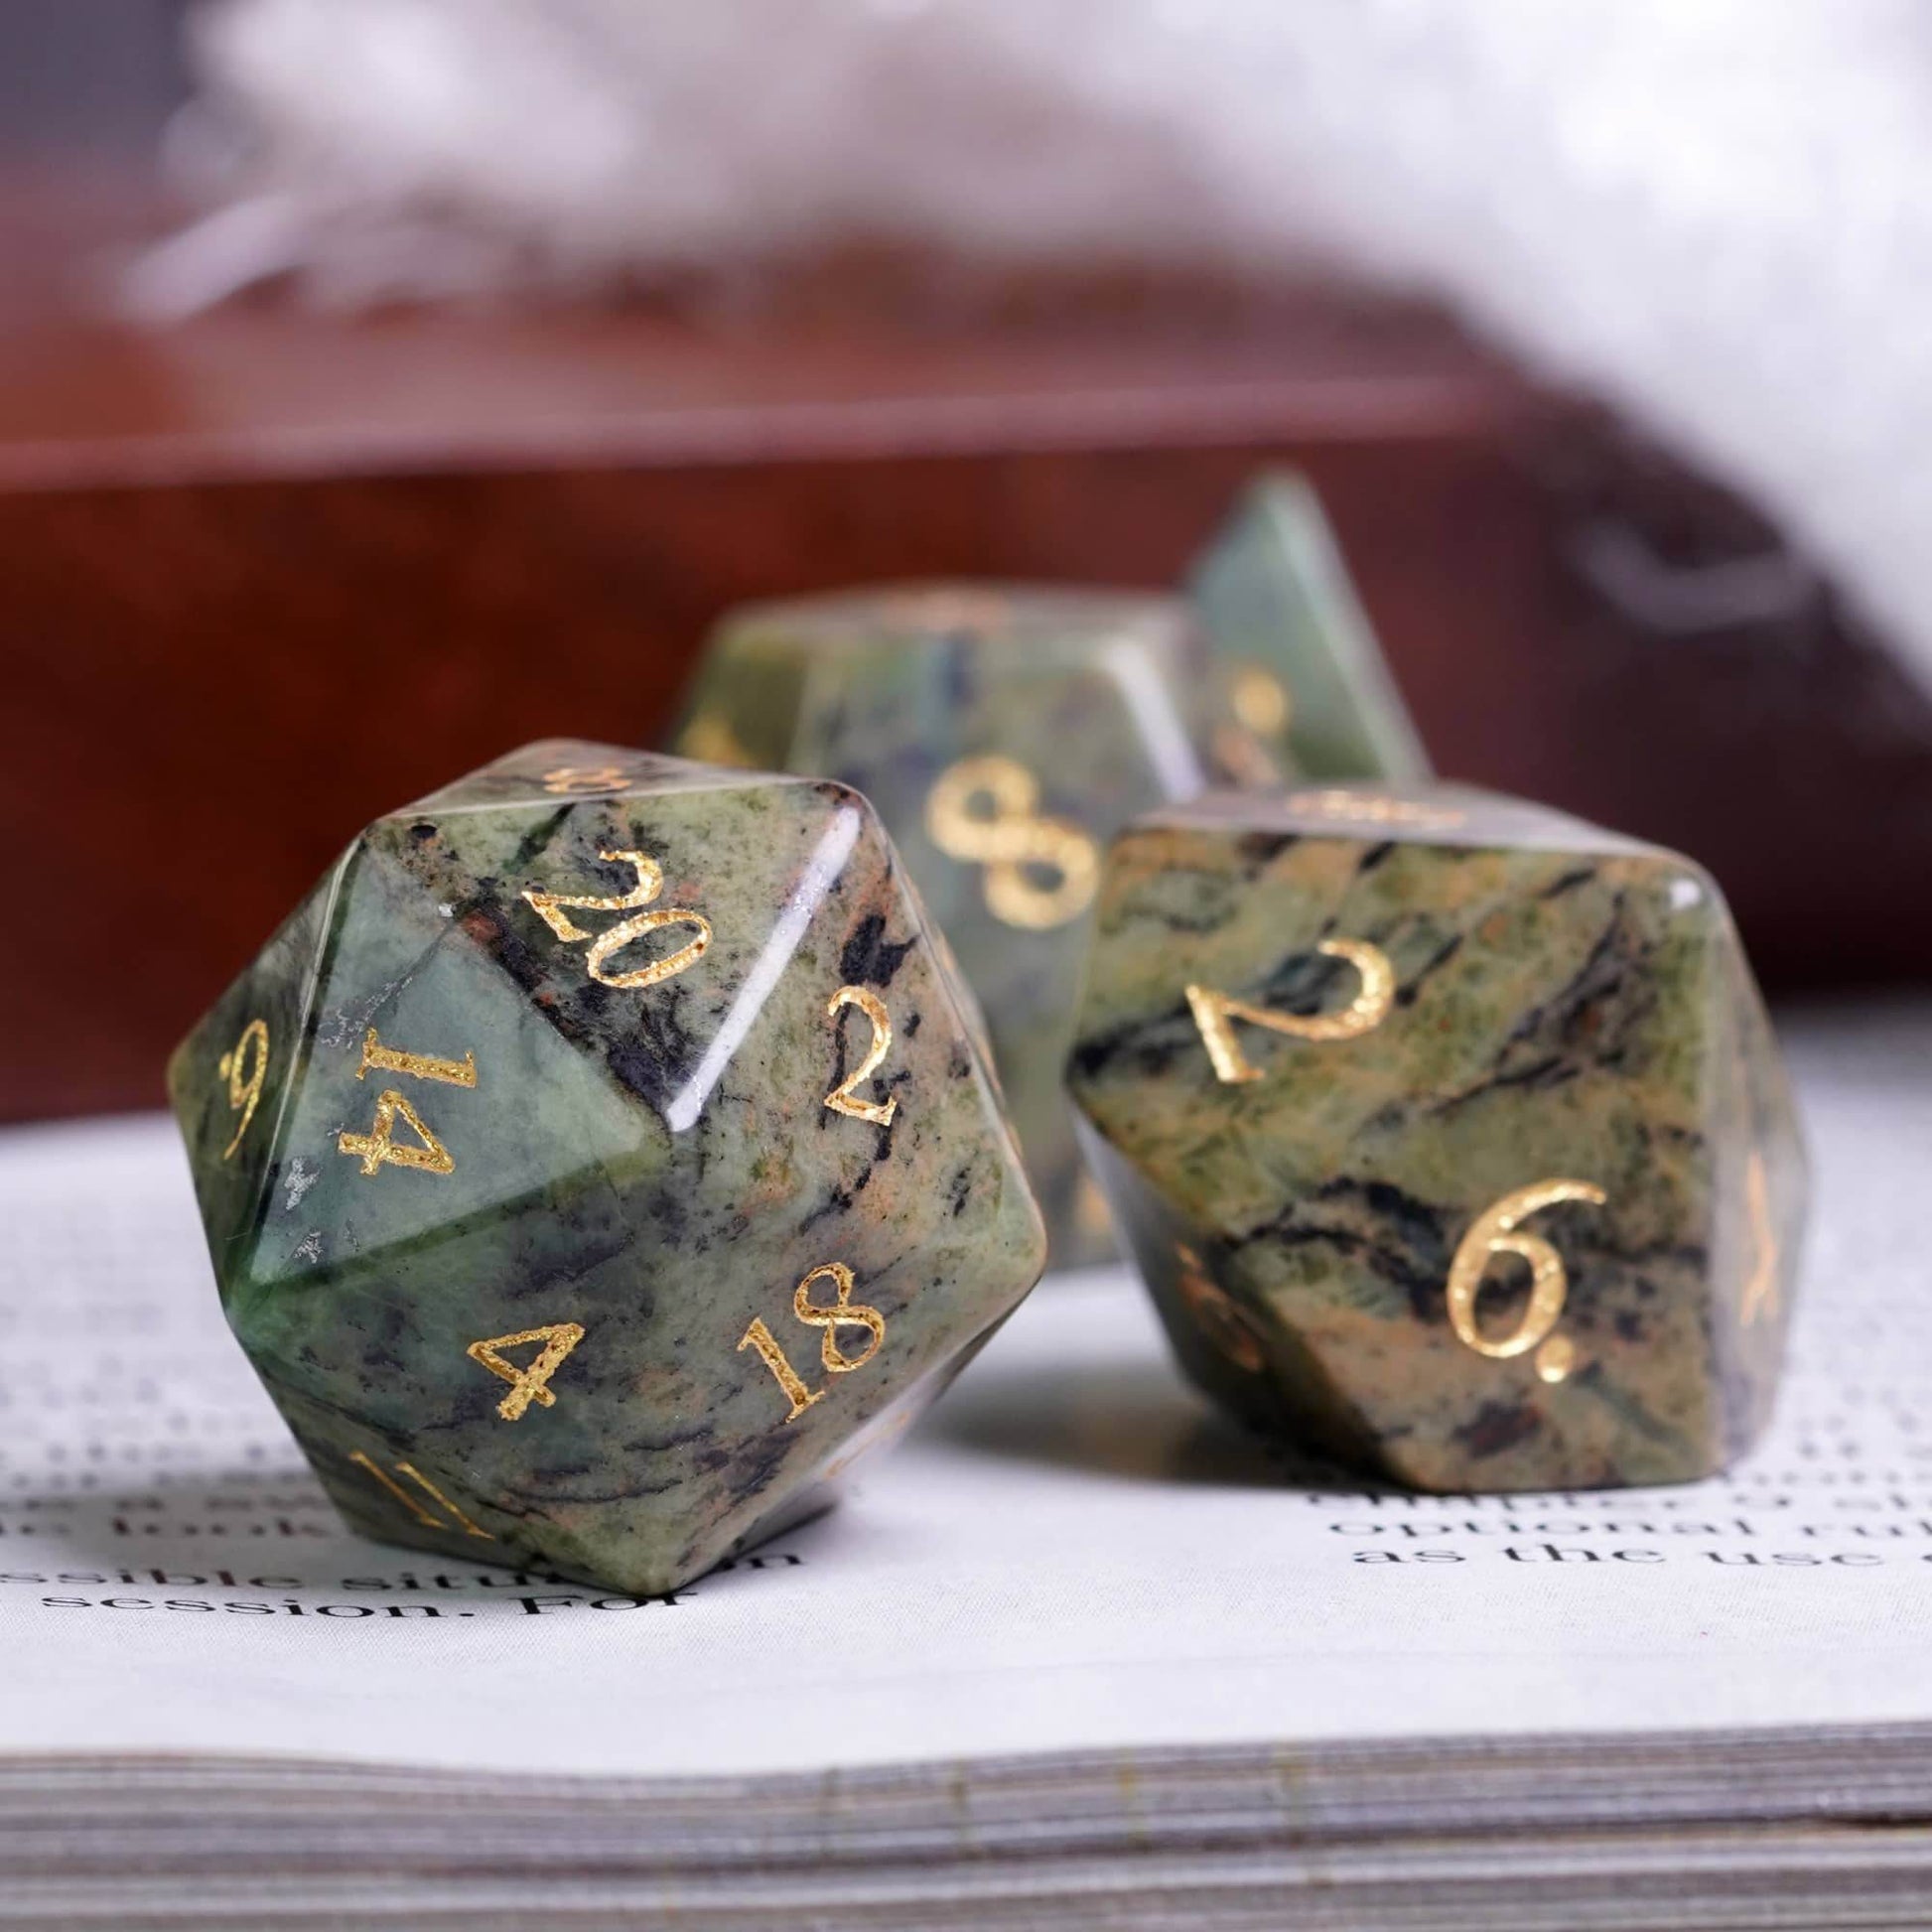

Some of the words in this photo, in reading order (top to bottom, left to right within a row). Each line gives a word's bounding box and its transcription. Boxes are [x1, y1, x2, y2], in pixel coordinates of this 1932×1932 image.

[925, 755, 1099, 930] 8
[521, 849, 713, 990] 20
[823, 986, 897, 1126] 2
[1184, 938, 1394, 1084] 2
[338, 1027, 478, 1175] 14
[467, 1322, 586, 1421] 4
[737, 1262, 885, 1424] 18
[1327, 1517, 1755, 1537] optional
[1353, 1550, 1467, 1564] as
[1501, 1543, 1667, 1564] the
[1703, 1551, 1885, 1567] use
[41, 1595, 476, 1619] session.
[507, 1590, 699, 1616] For
